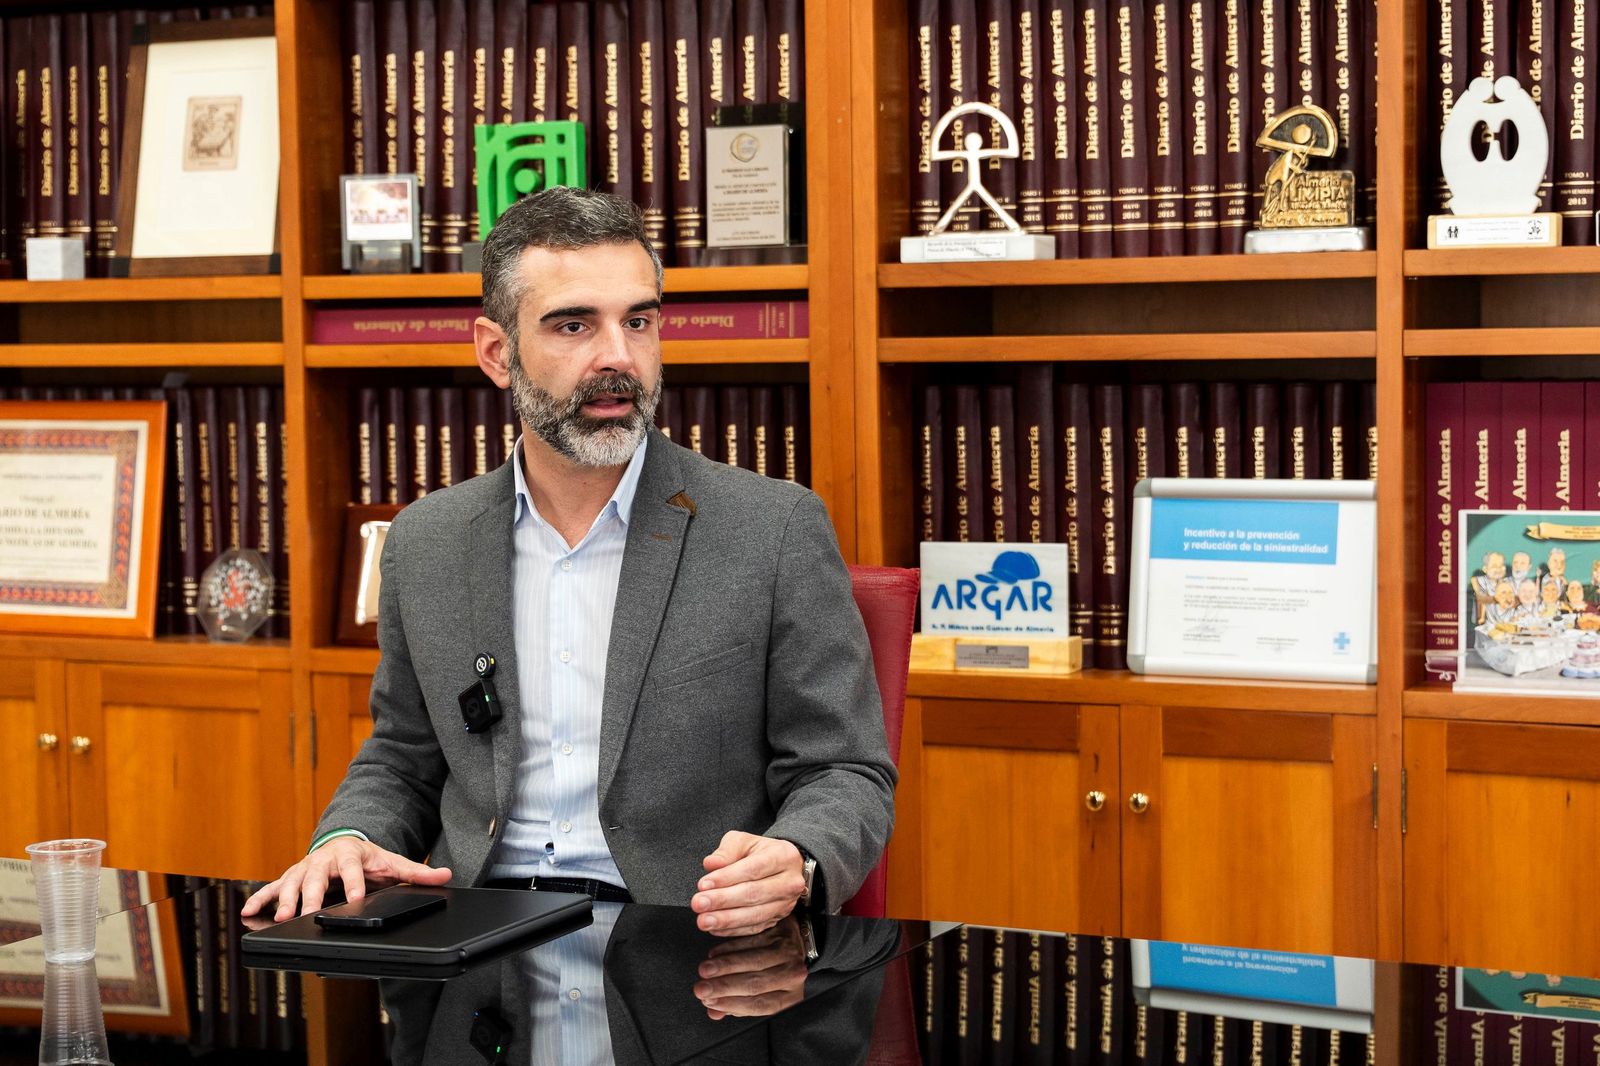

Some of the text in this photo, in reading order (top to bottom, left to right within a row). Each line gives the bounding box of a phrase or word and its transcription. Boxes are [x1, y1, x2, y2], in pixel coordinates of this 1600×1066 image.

[474, 48, 485, 111] Almería
[501, 47, 514, 111] Almería
[533, 48, 545, 111] Almería
[566, 46, 578, 109] Almería
[710, 37, 723, 102] Almería
[743, 35, 755, 101] Almería
[778, 33, 790, 100] Almería
[919, 26, 931, 93] Almería
[950, 24, 962, 92] Almería
[988, 21, 1001, 89] Almería
[1020, 11, 1035, 161] Diario de Almería
[1050, 9, 1068, 159] Diario de Almería
[1083, 9, 1099, 159] Diario de Almería
[1118, 7, 1135, 158] Diario de Almería
[1154, 4, 1170, 156] Diario de Almería
[1190, 2, 1207, 155] Diario de Almería
[1227, 72, 1240, 94] de
[1262, 72, 1275, 94] de
[1300, 70, 1313, 92] de
[1336, 68, 1349, 90] de
[1441, 62, 1453, 85] de
[1530, 58, 1542, 81] de
[1571, 56, 1585, 78] de
[413, 51, 425, 136] de Almería
[442, 51, 454, 188] Diario de Almería
[605, 43, 619, 184] Diario de Almería
[641, 42, 653, 183] Diario de Almería
[675, 39, 690, 181] Diario de Almería
[920, 96, 931, 117] de
[1228, 98, 1240, 153] Diario
[1570, 82, 1585, 140] Diario
[1056, 213, 1074, 221] 2013
[1122, 212, 1141, 220] 2013
[1157, 210, 1176, 218] 2013
[1228, 208, 1245, 216] 2013
[353, 319, 469, 333] Diario de Almería
[669, 315, 735, 329] Diario de
[921, 425, 932, 491] Almería
[956, 426, 968, 516] de Almería
[990, 426, 1003, 516] de Almería
[1029, 426, 1040, 516] de Almería
[1065, 426, 1077, 517] de Almería
[1475, 429, 1489, 502] Almería
[1513, 428, 1527, 502] Almería
[1556, 429, 1570, 503] Almería
[1101, 427, 1116, 575] Diario de Almería
[1438, 428, 1452, 584] Diario de Almería
[1184, 528, 1300, 542] Incentivo a la prevención
[1184, 541, 1329, 554] y reducción de la siniestralidad
[931, 580, 1053, 621] ARGAR
[1436, 637, 1455, 645] 2016
